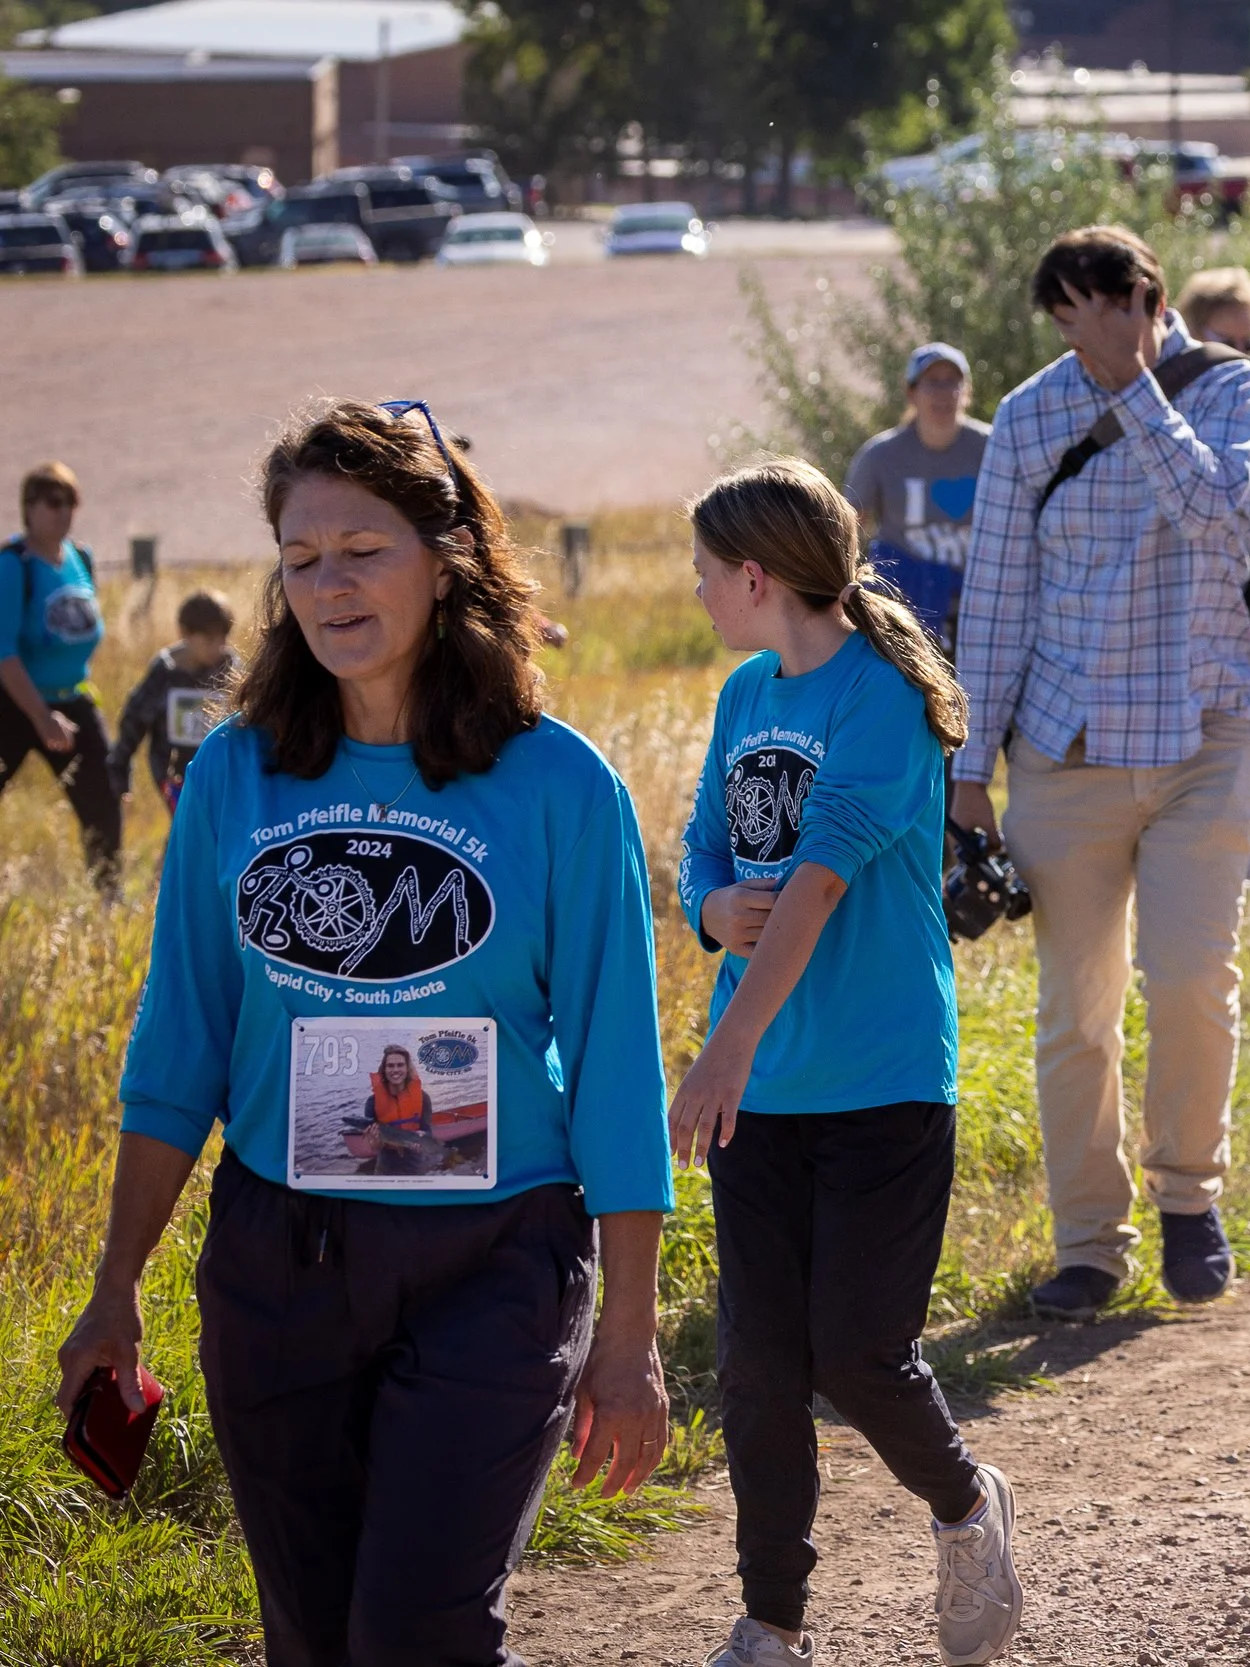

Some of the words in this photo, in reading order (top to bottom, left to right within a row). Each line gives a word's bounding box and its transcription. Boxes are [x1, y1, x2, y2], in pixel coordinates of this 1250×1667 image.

[904, 478, 925, 526] I
[809, 741, 826, 762] 5k
[250, 820, 294, 847] Tom
[298, 803, 363, 831] Pfeifle
[367, 803, 466, 846] Memorial
[461, 835, 490, 864] 5k
[345, 840, 393, 859] 2024
[304, 979, 334, 1003] City
[344, 988, 390, 1005] South
[392, 978, 447, 1004] Dakota
[418, 1033, 437, 1044] Tom
[438, 1029, 466, 1039] Pfeifle
[466, 1033, 478, 1044] 5k
[304, 1035, 361, 1077] 793
